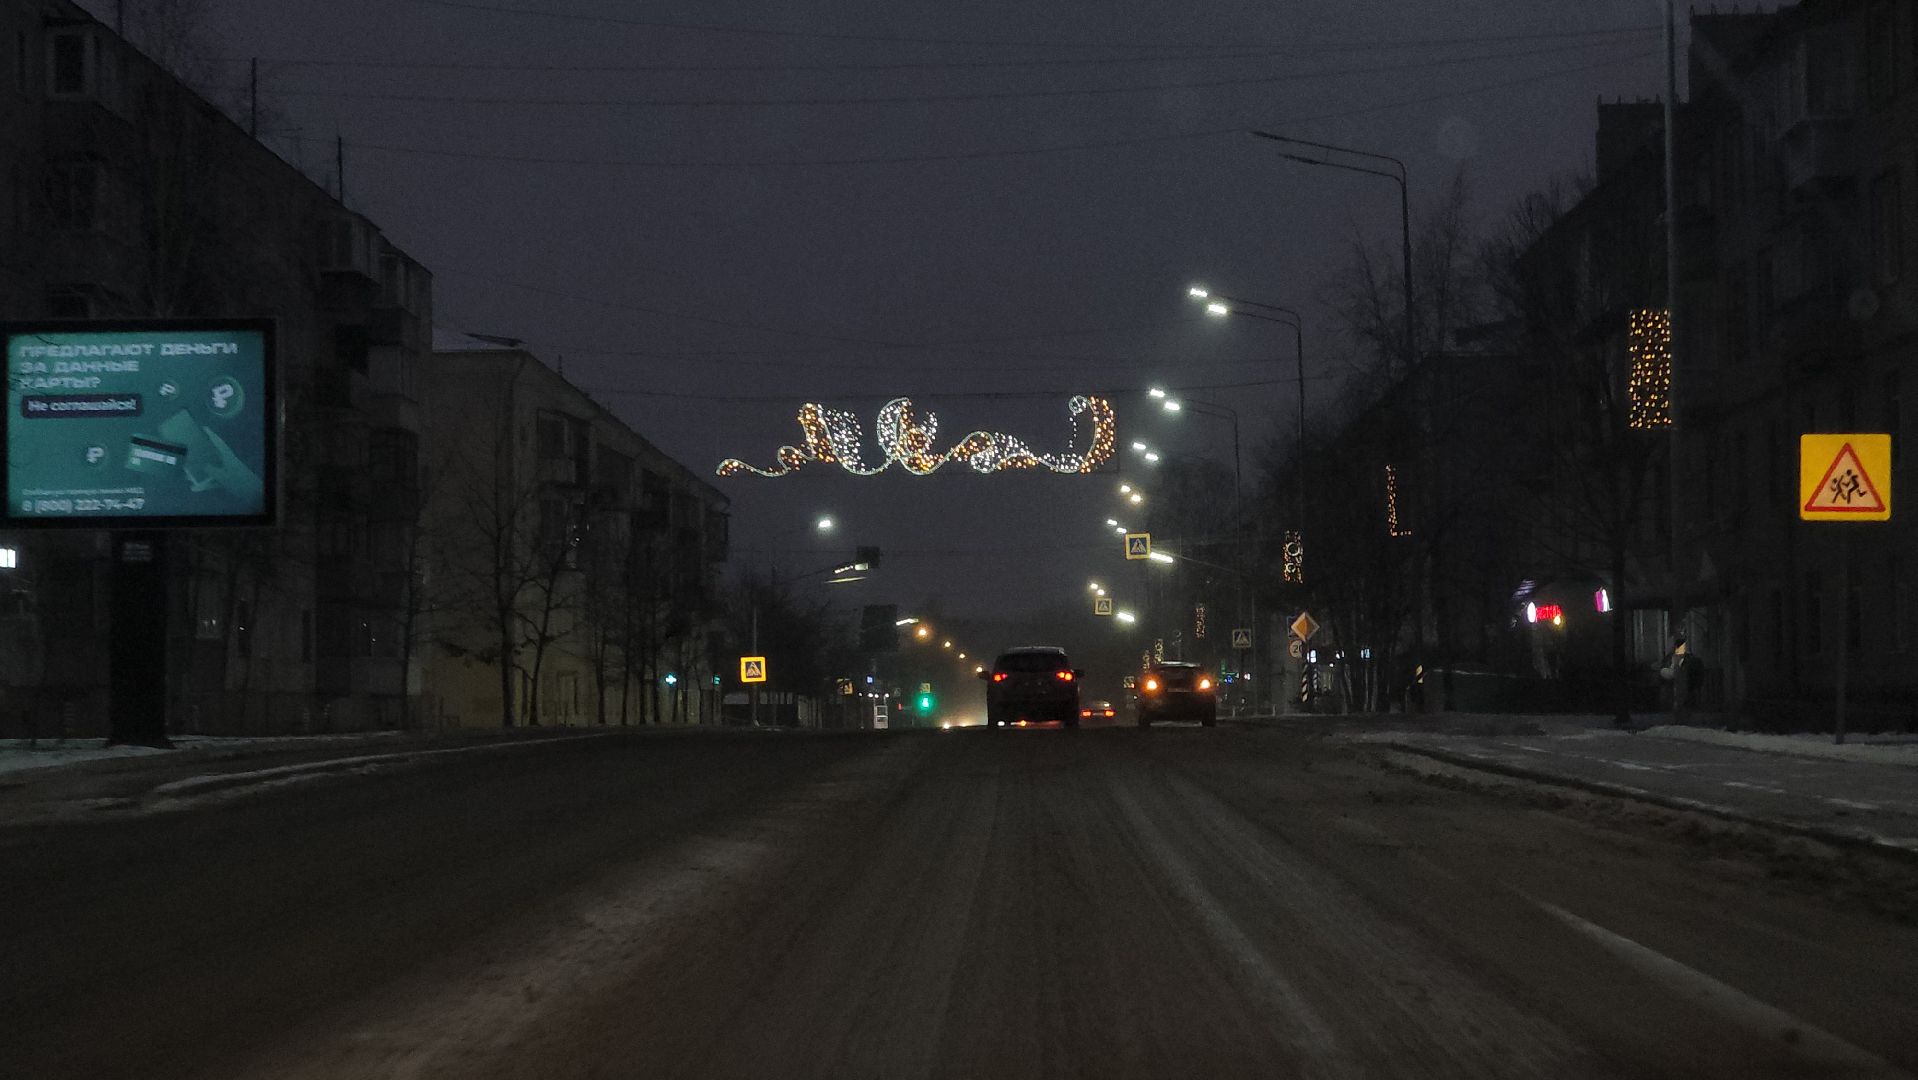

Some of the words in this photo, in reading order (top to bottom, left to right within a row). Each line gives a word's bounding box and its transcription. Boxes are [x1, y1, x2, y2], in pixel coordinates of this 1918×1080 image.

[19, 344, 155, 357] ПРЕДЛАГАЮТ
[160, 342, 238, 356] ДЕНЬГИ
[20, 361, 48, 373] ЗА
[53, 360, 140, 373] ДАННЫЕ
[19, 376, 101, 389] КАРТЫ?
[28, 400, 48, 411] Не
[49, 398, 137, 411] соглашайся!
